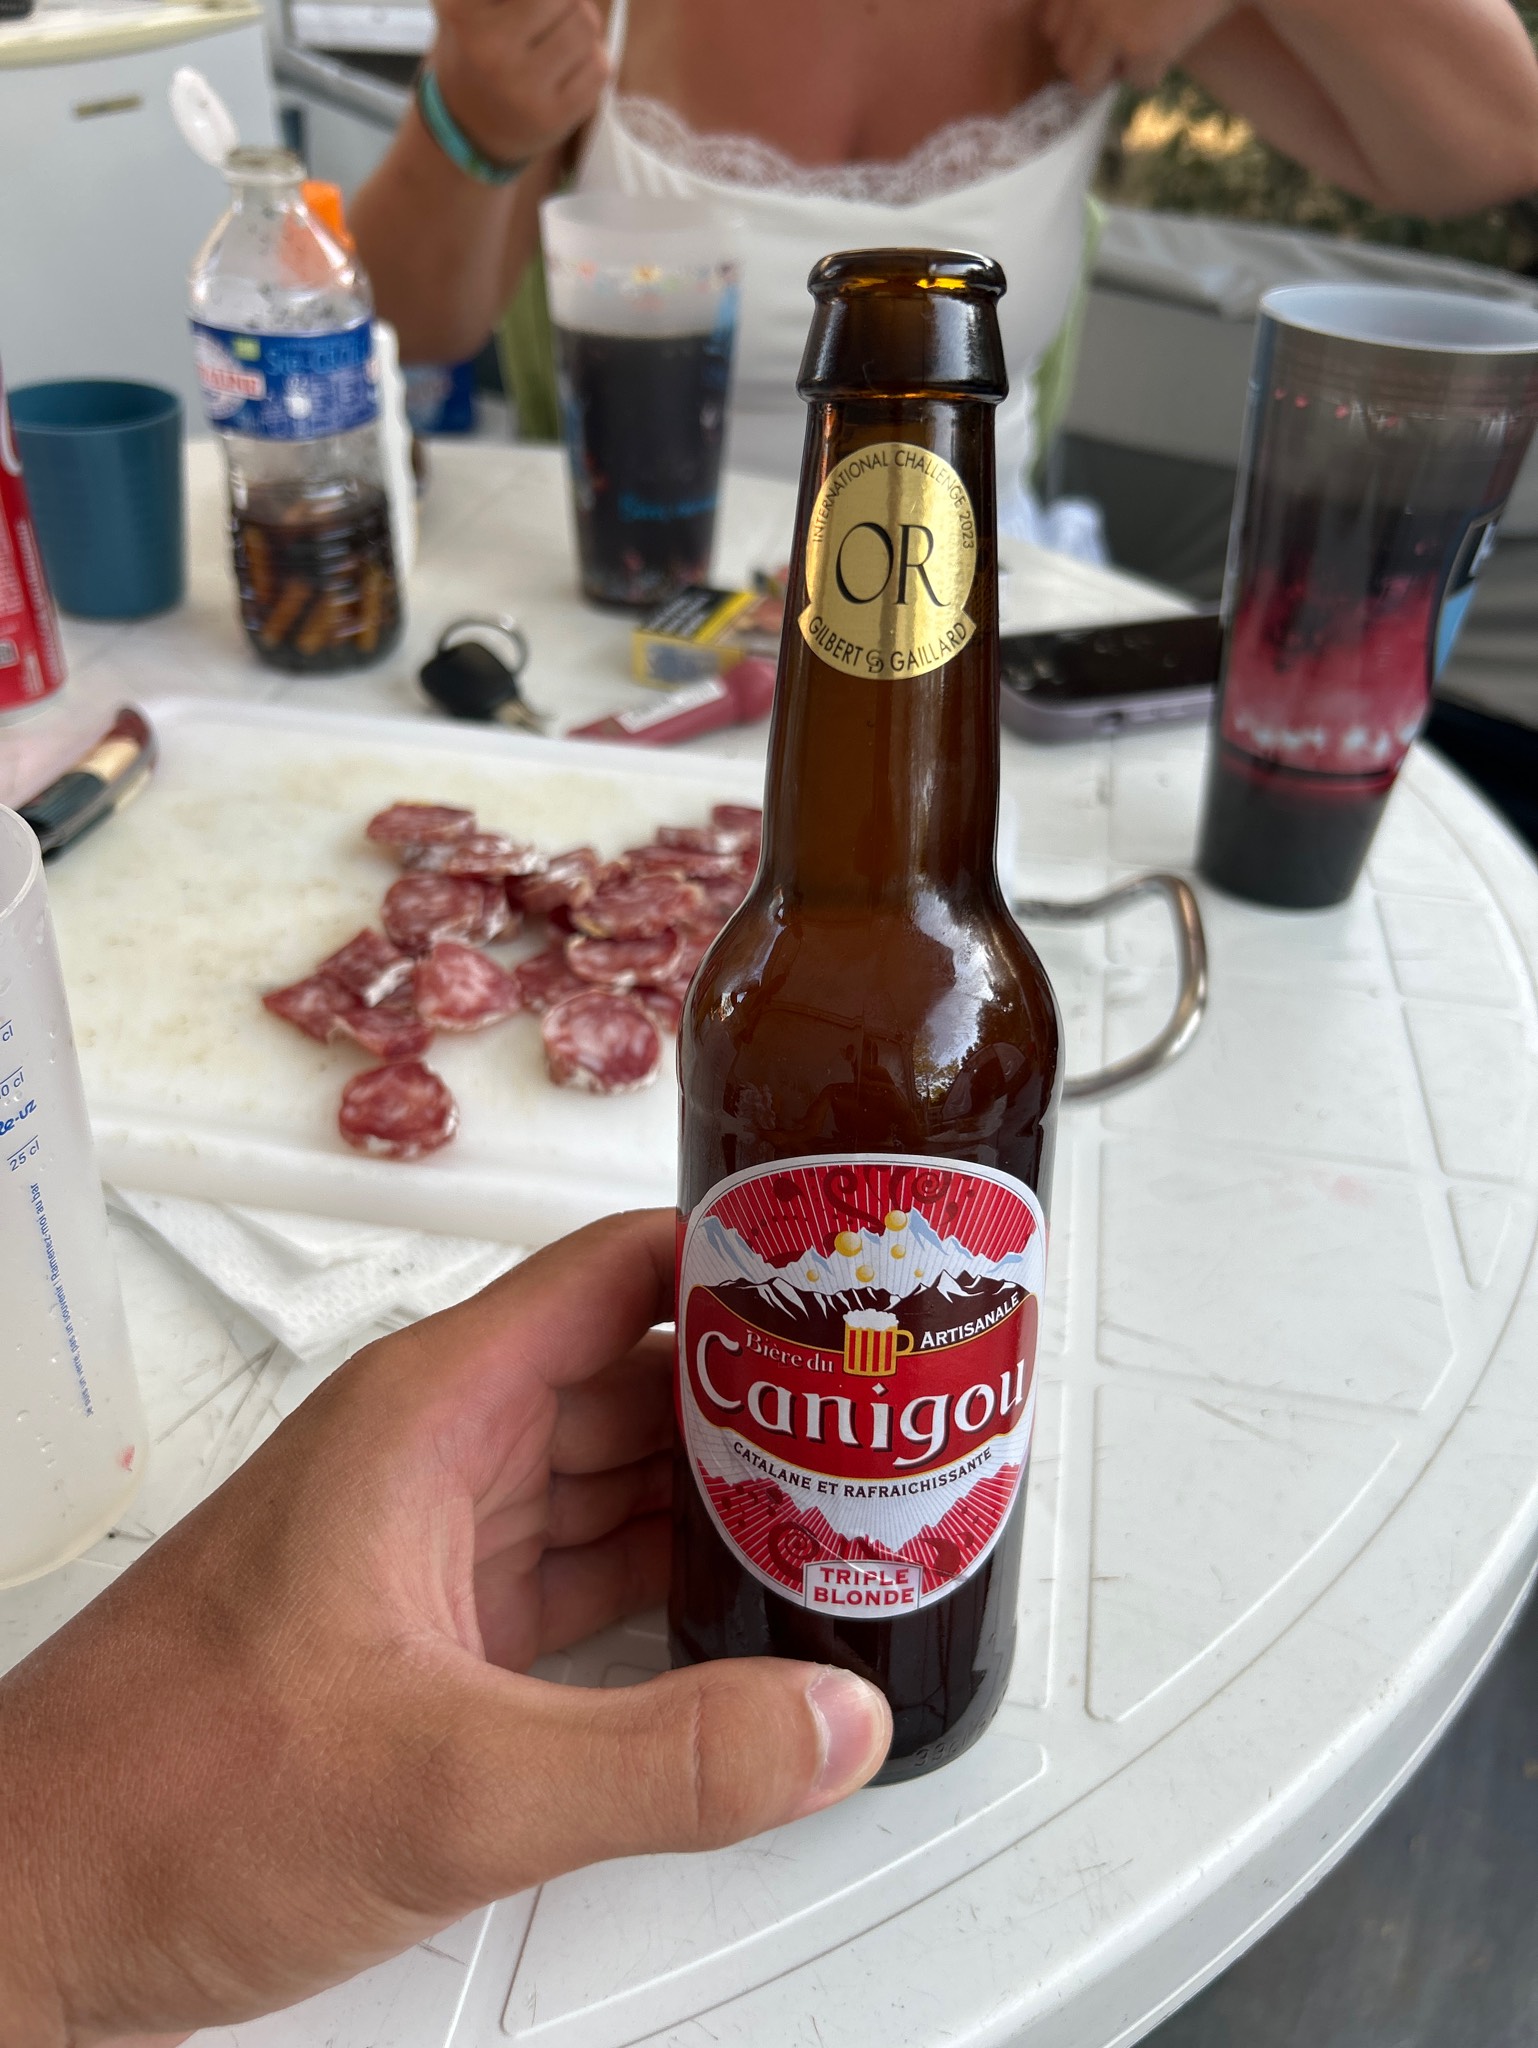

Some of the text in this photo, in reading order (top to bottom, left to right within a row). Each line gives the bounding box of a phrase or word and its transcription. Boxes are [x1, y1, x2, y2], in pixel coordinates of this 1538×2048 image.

[813, 449, 975, 550] INTERNATIONAL CHALLENGE 2023
[835, 522, 951, 607] OR
[808, 615, 864, 667] GILBERT
[890, 621, 967, 672] GAILLARD
[0, 1071, 24, 1100] 0 cl
[9, 1139, 40, 1172] 25 cl
[31, 1183, 40, 1203] bar
[35, 1199, 45, 1214] au
[57, 1285, 70, 1324] souvenir
[920, 1291, 1020, 1349] ARTISANALE
[65, 1323, 73, 1336] un
[67, 1335, 79, 1353] pas
[745, 1328, 834, 1373] Bière du
[696, 1330, 1025, 1470] Canigou
[733, 1441, 993, 1499] CATALANE ET RAFRAICHISSANTE
[819, 1566, 910, 1587] TRIPLE
[813, 1585, 916, 1606] BLONDE
